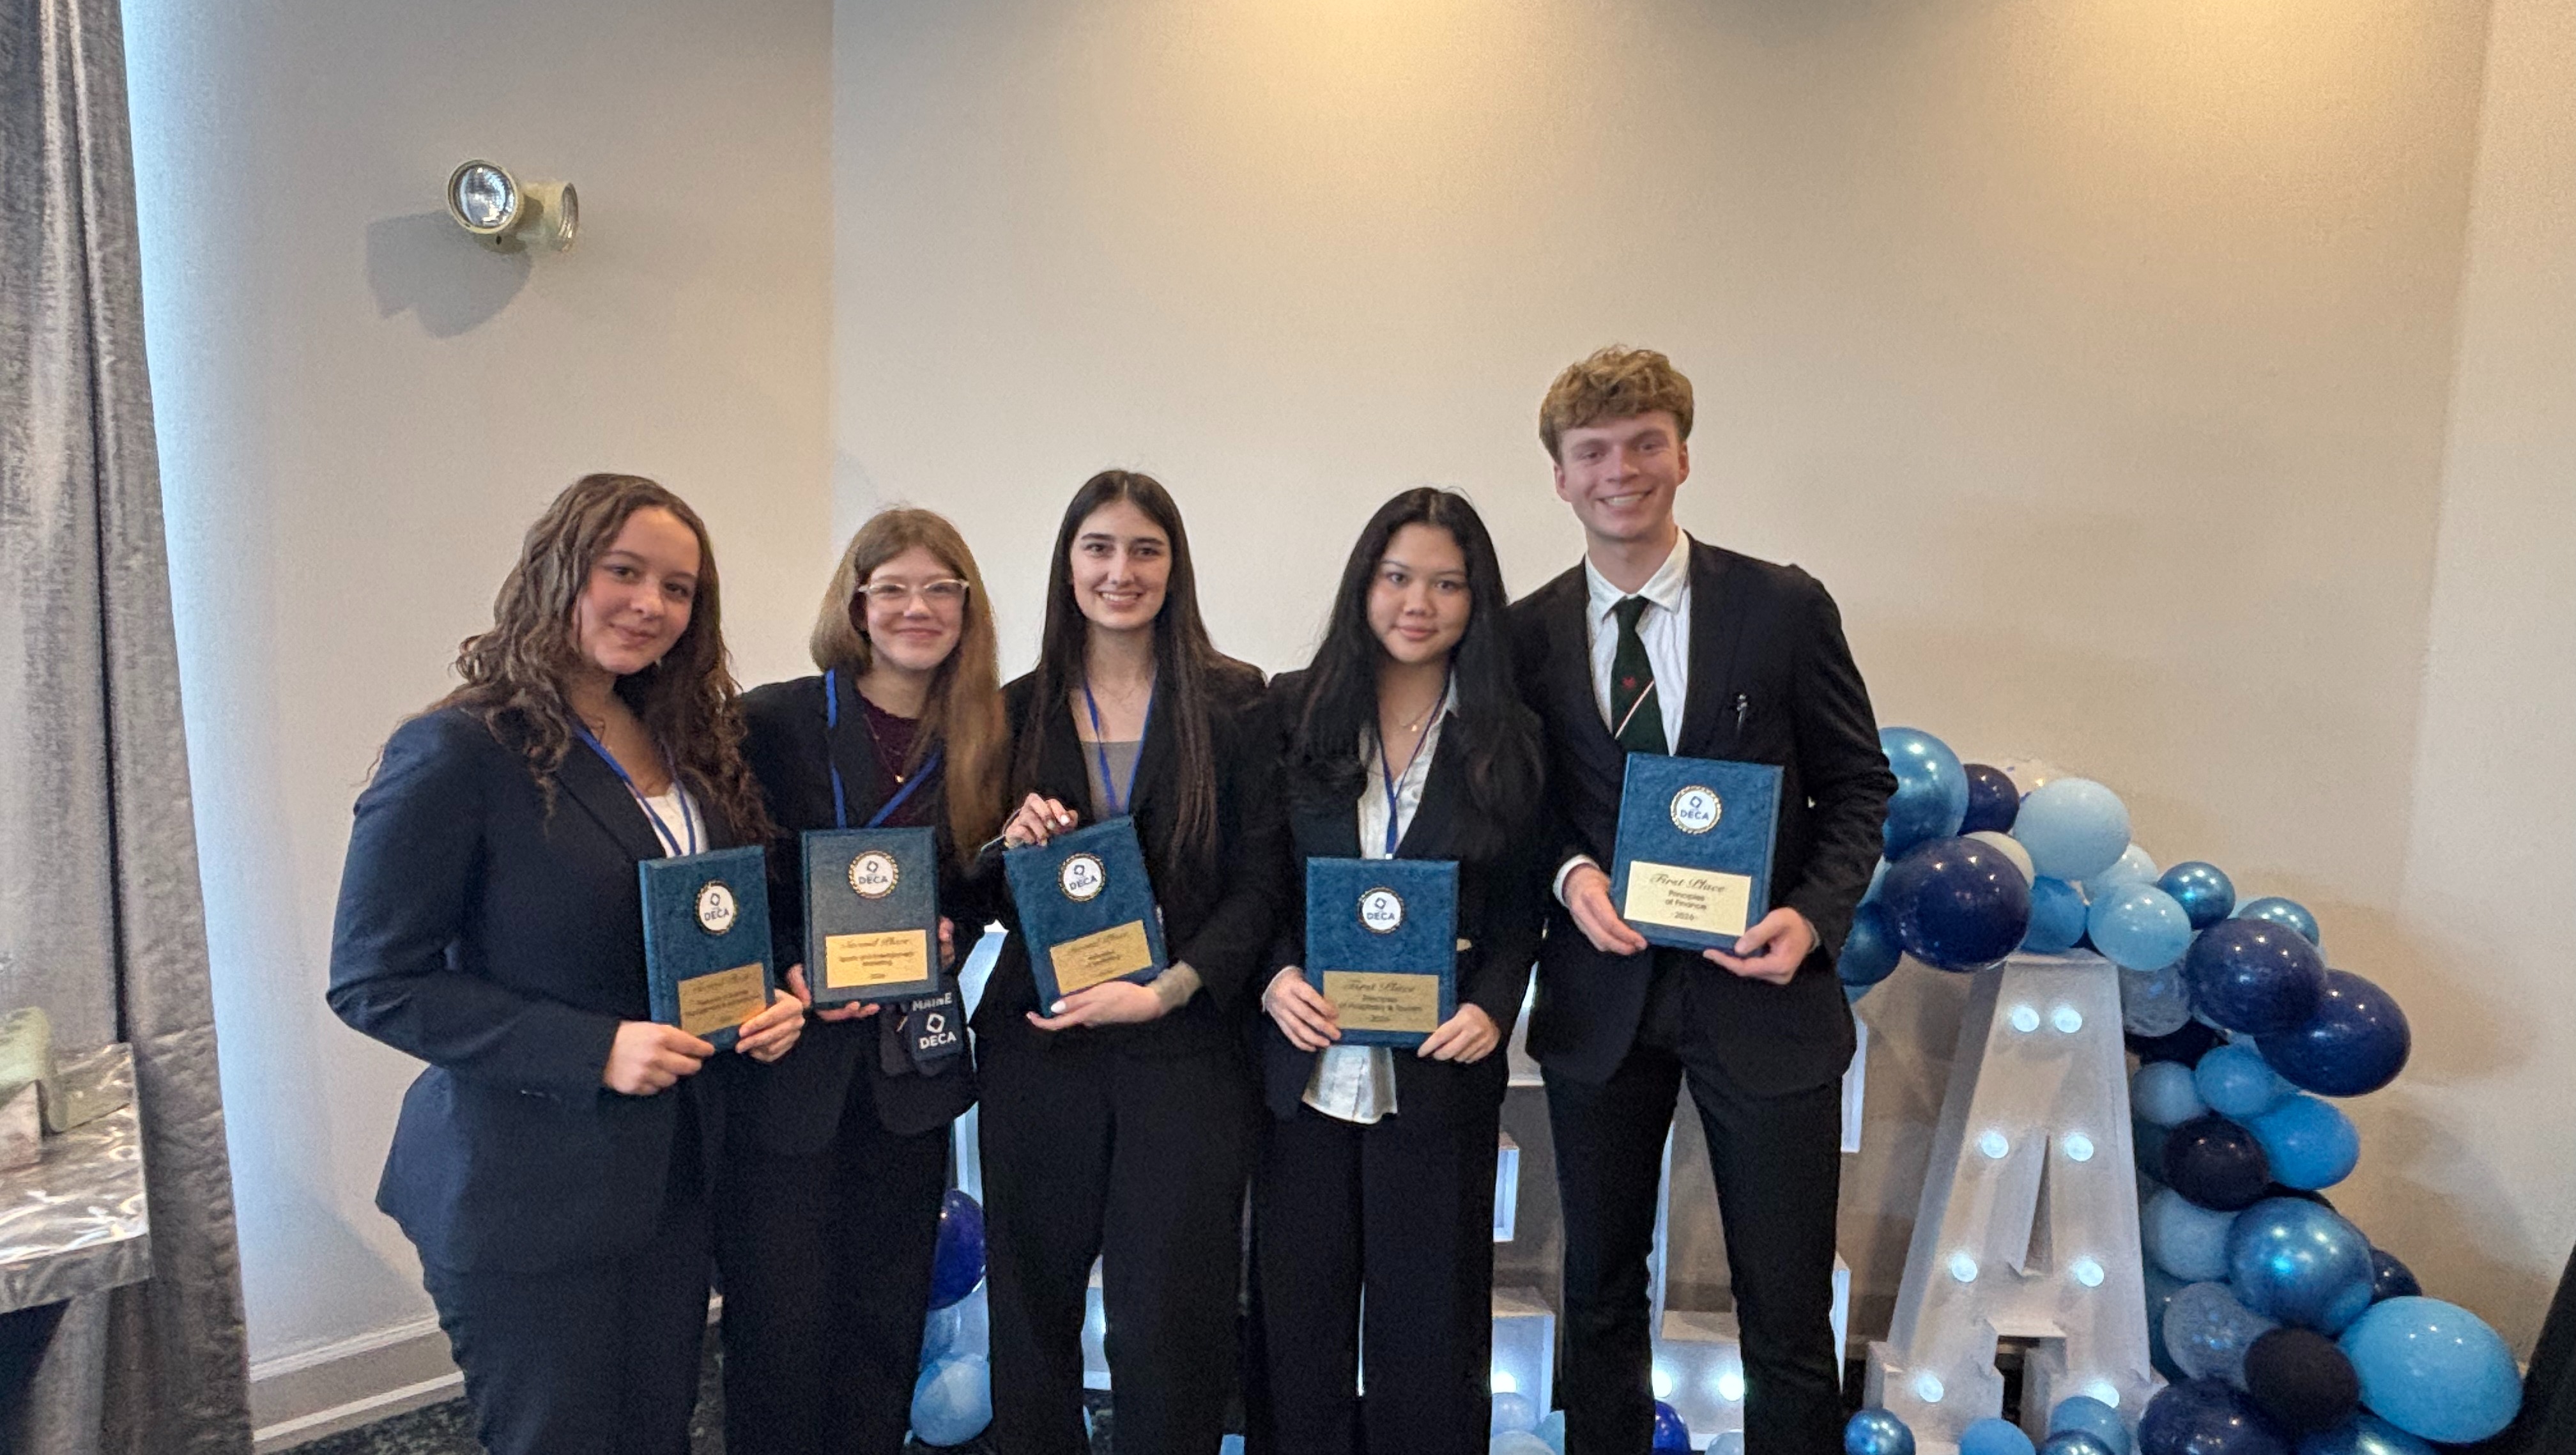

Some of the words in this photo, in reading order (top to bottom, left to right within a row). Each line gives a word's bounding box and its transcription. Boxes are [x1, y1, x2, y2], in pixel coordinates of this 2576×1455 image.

[1680, 809, 1709, 820] DECA
[859, 875, 888, 885] DECA
[1069, 874, 1098, 890] DECA
[1650, 874, 1685, 886] First
[1686, 879, 1726, 892] Place
[704, 907, 730, 921] DECA
[1366, 911, 1395, 921] DECA
[912, 992, 952, 1011] MAINE
[919, 1031, 957, 1049] DECA
